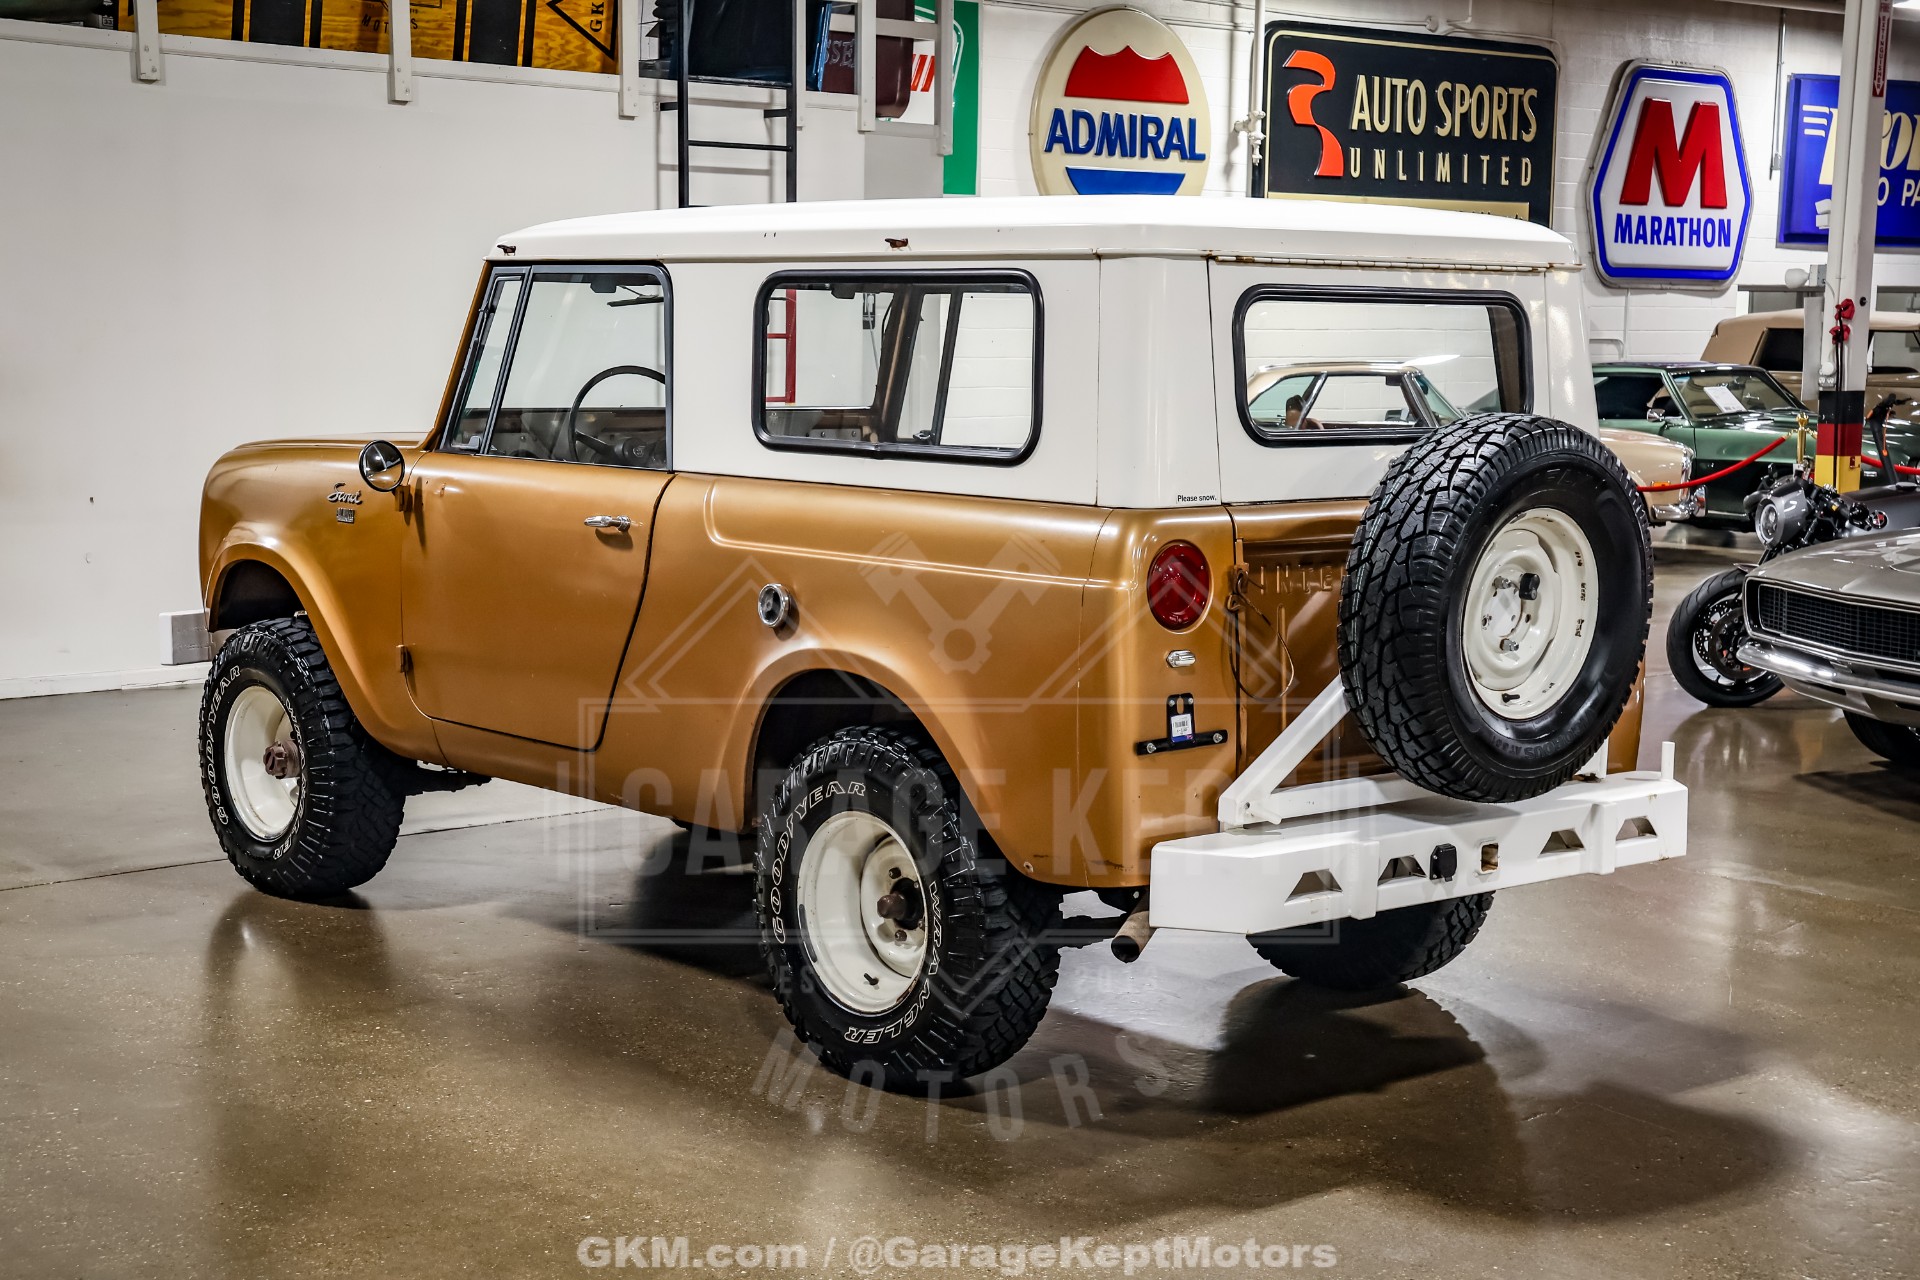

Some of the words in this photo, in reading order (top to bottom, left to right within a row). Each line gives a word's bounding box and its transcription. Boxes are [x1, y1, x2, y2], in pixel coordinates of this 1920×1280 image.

[362, 13, 418, 34] MOTS
[1044, 107, 1206, 161] ADMIRAL
[1349, 74, 1427, 136] AUTO
[1435, 80, 1538, 143] SPORTS
[1349, 147, 1532, 187] UNLIMITED
[1614, 213, 1731, 248] MARATHON
[206, 665, 241, 825] GOODYEAR
[772, 781, 866, 944] GOODYEAR
[845, 881, 943, 1044] WRANGLER
